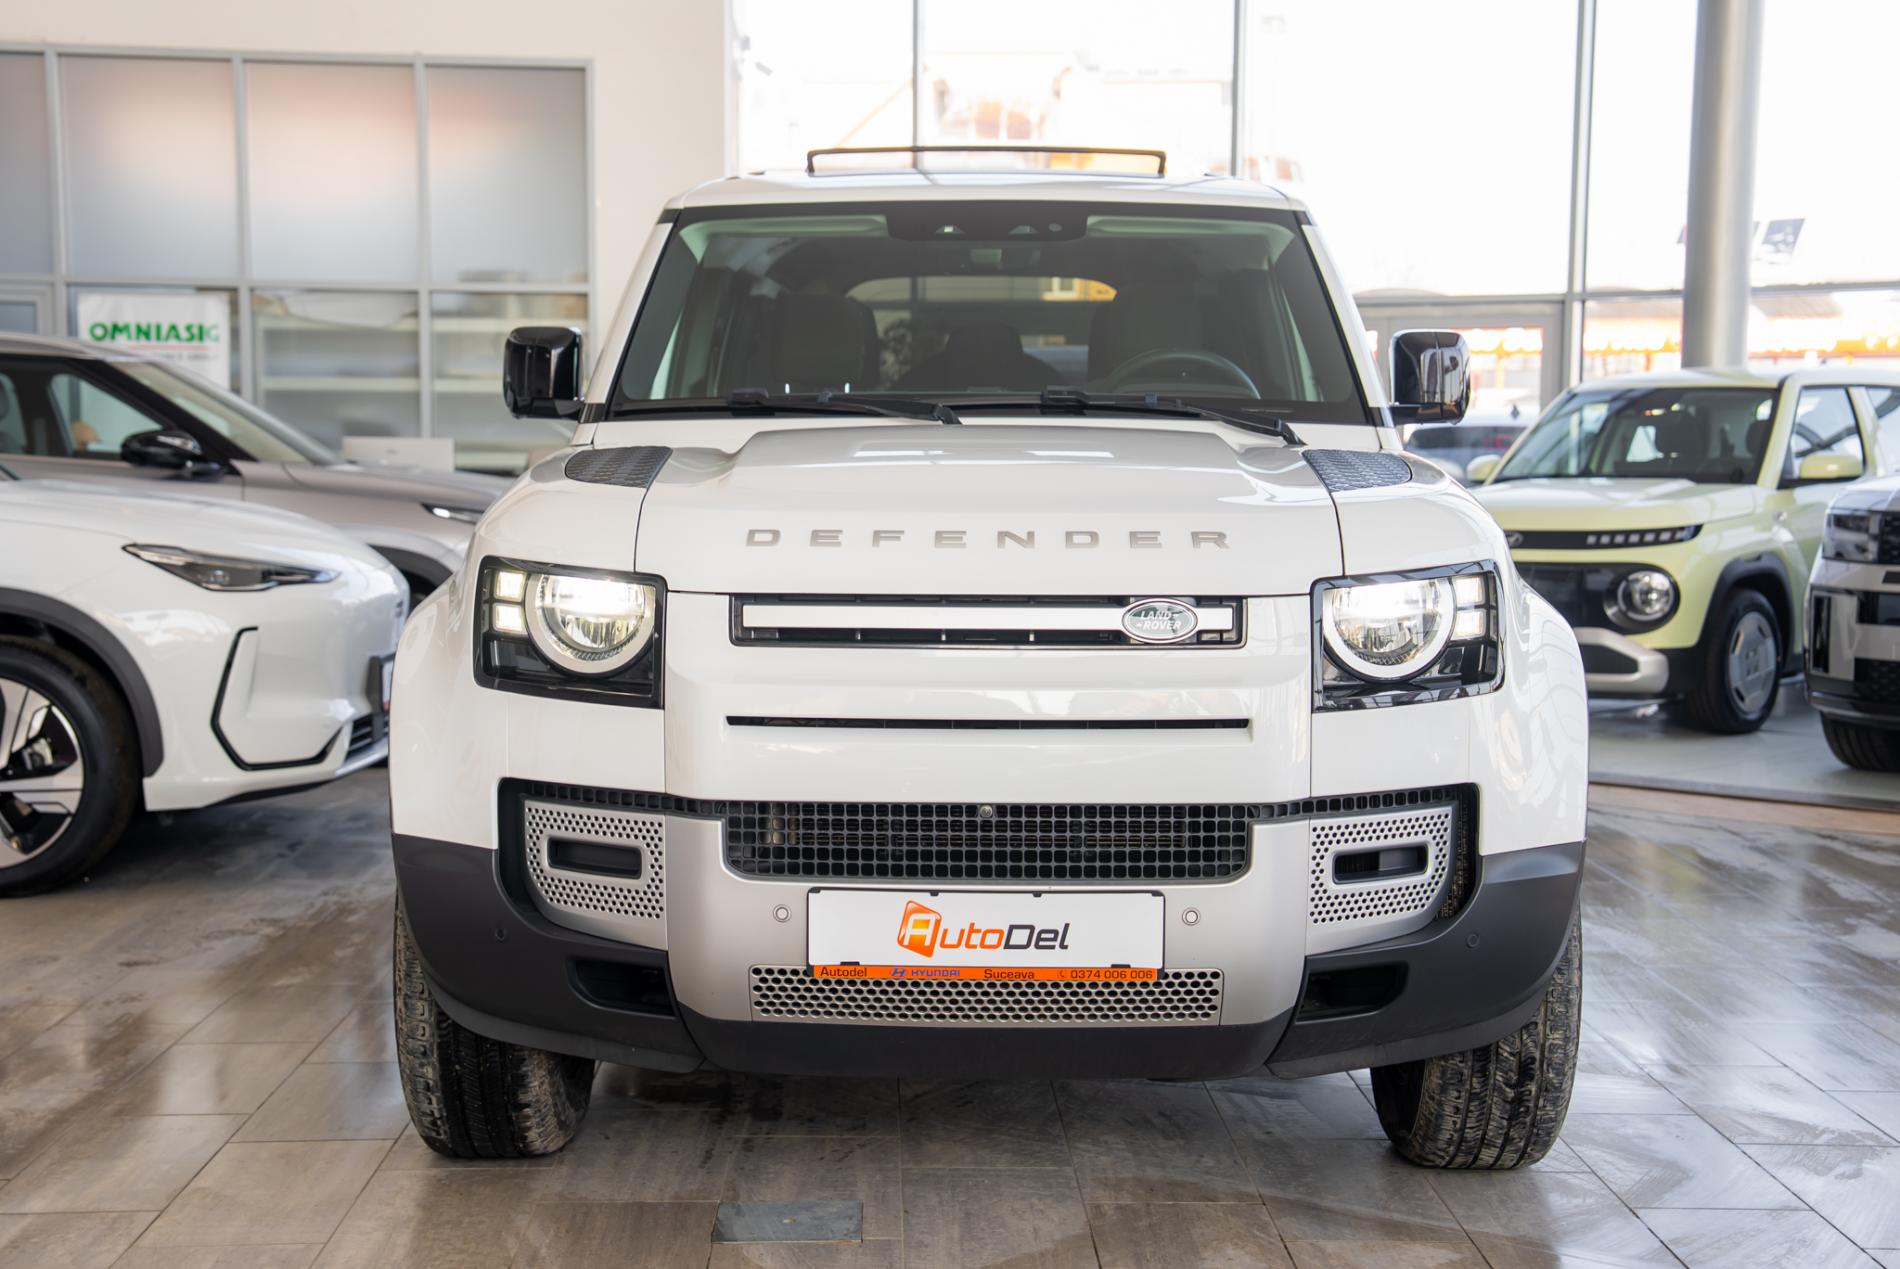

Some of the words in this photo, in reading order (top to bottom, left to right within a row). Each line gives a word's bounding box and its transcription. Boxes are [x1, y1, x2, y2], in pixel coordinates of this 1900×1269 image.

[745, 529, 1230, 549] DEFENDER
[1143, 620, 1182, 630] ROVER
[900, 912, 1070, 951] AutoDel
[820, 966, 867, 977] Autodel
[911, 969, 960, 977] HYUNDAI
[984, 968, 1035, 979] Suceava
[1070, 970, 1100, 979] 0374
[1104, 970, 1127, 979] 006
[1130, 970, 1153, 979] 006
